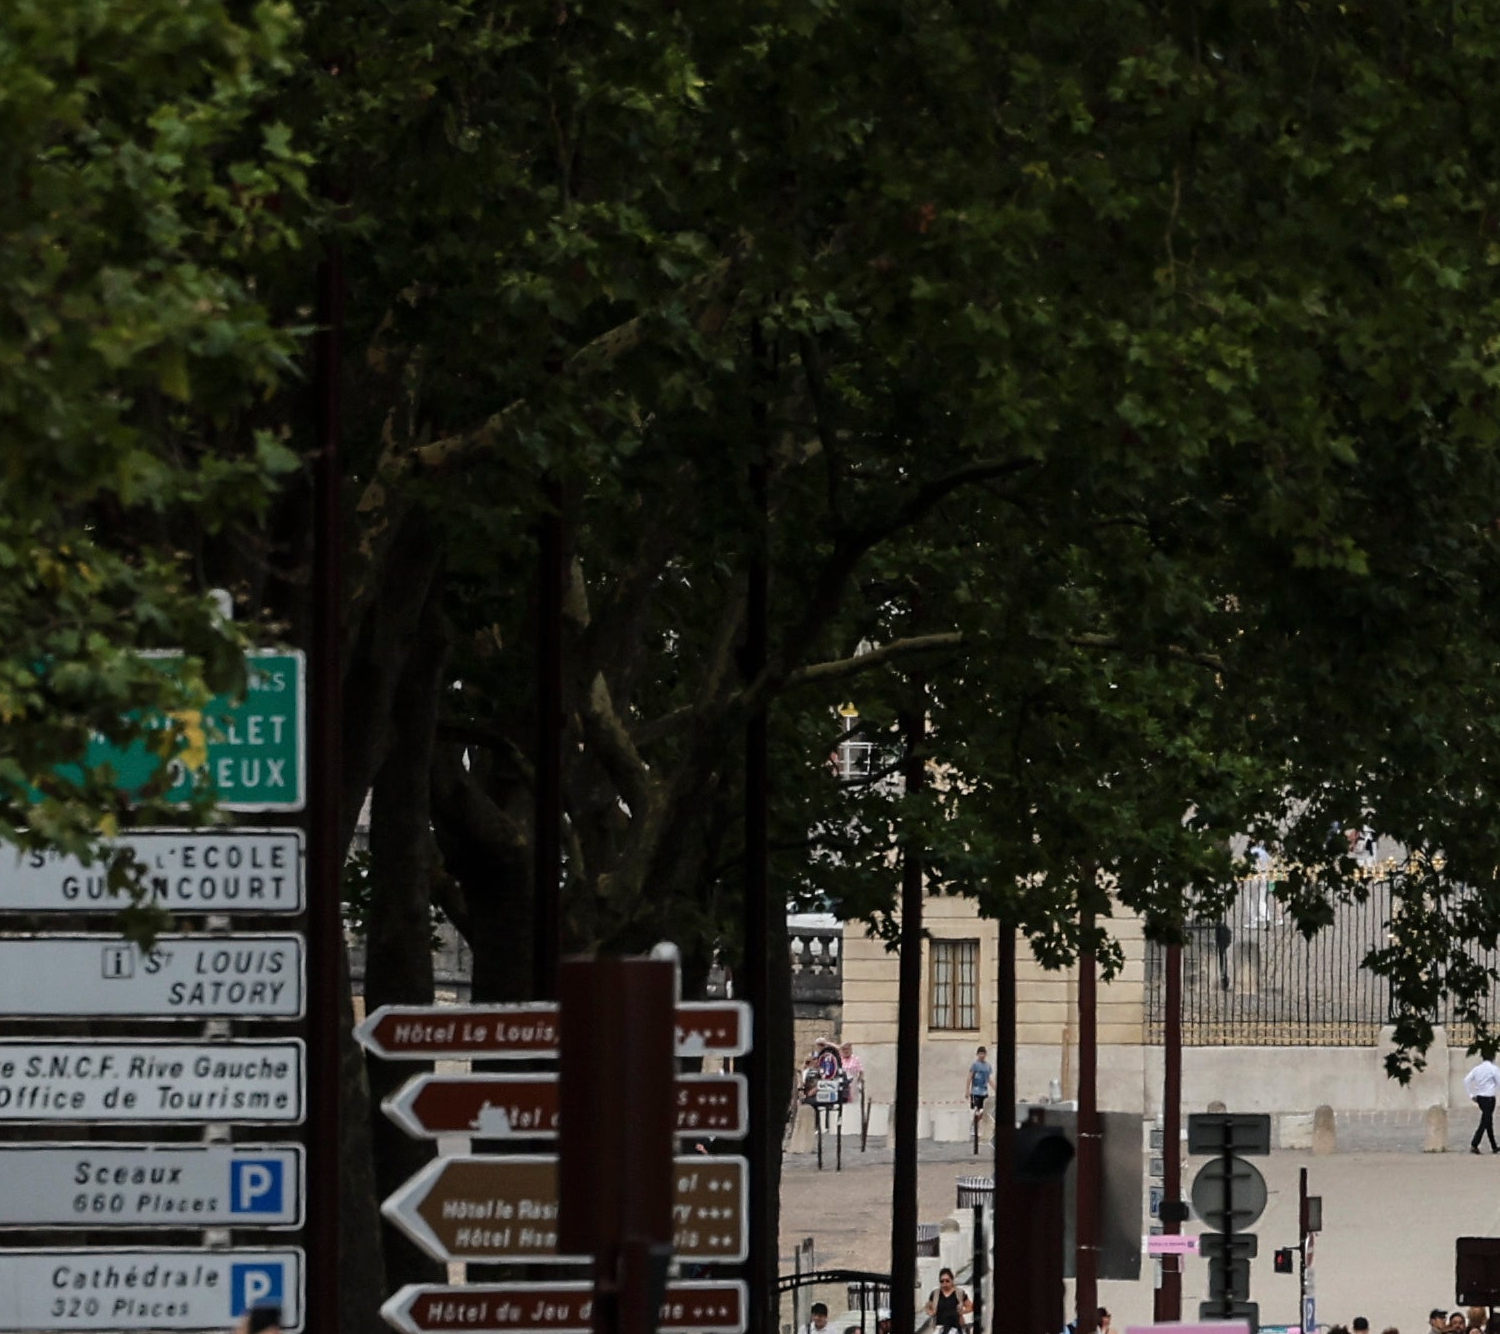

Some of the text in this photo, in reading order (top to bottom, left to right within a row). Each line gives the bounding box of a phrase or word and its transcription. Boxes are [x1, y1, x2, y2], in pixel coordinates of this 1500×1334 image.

[61, 875, 287, 902] GUNCOURT
[196, 950, 286, 975] LOUIS
[167, 981, 286, 1006] SATORY
[393, 1019, 456, 1043] Hôtel
[462, 1019, 487, 1042] Le
[126, 1054, 185, 1080] Rive
[193, 1054, 289, 1080] Gauche
[102, 1085, 138, 1110] de
[158, 1085, 289, 1110] Tourisme
[73, 1161, 273, 1210] Sceaux P
[72, 1192, 219, 1214] 660 Places
[455, 1227, 511, 1247] Hôtel
[51, 1264, 220, 1290] Cathédrale
[50, 1297, 190, 1317] 320 Places
[427, 1300, 488, 1323] Hôtel
[496, 1301, 522, 1322] du
[530, 1301, 569, 1322] Jeu
